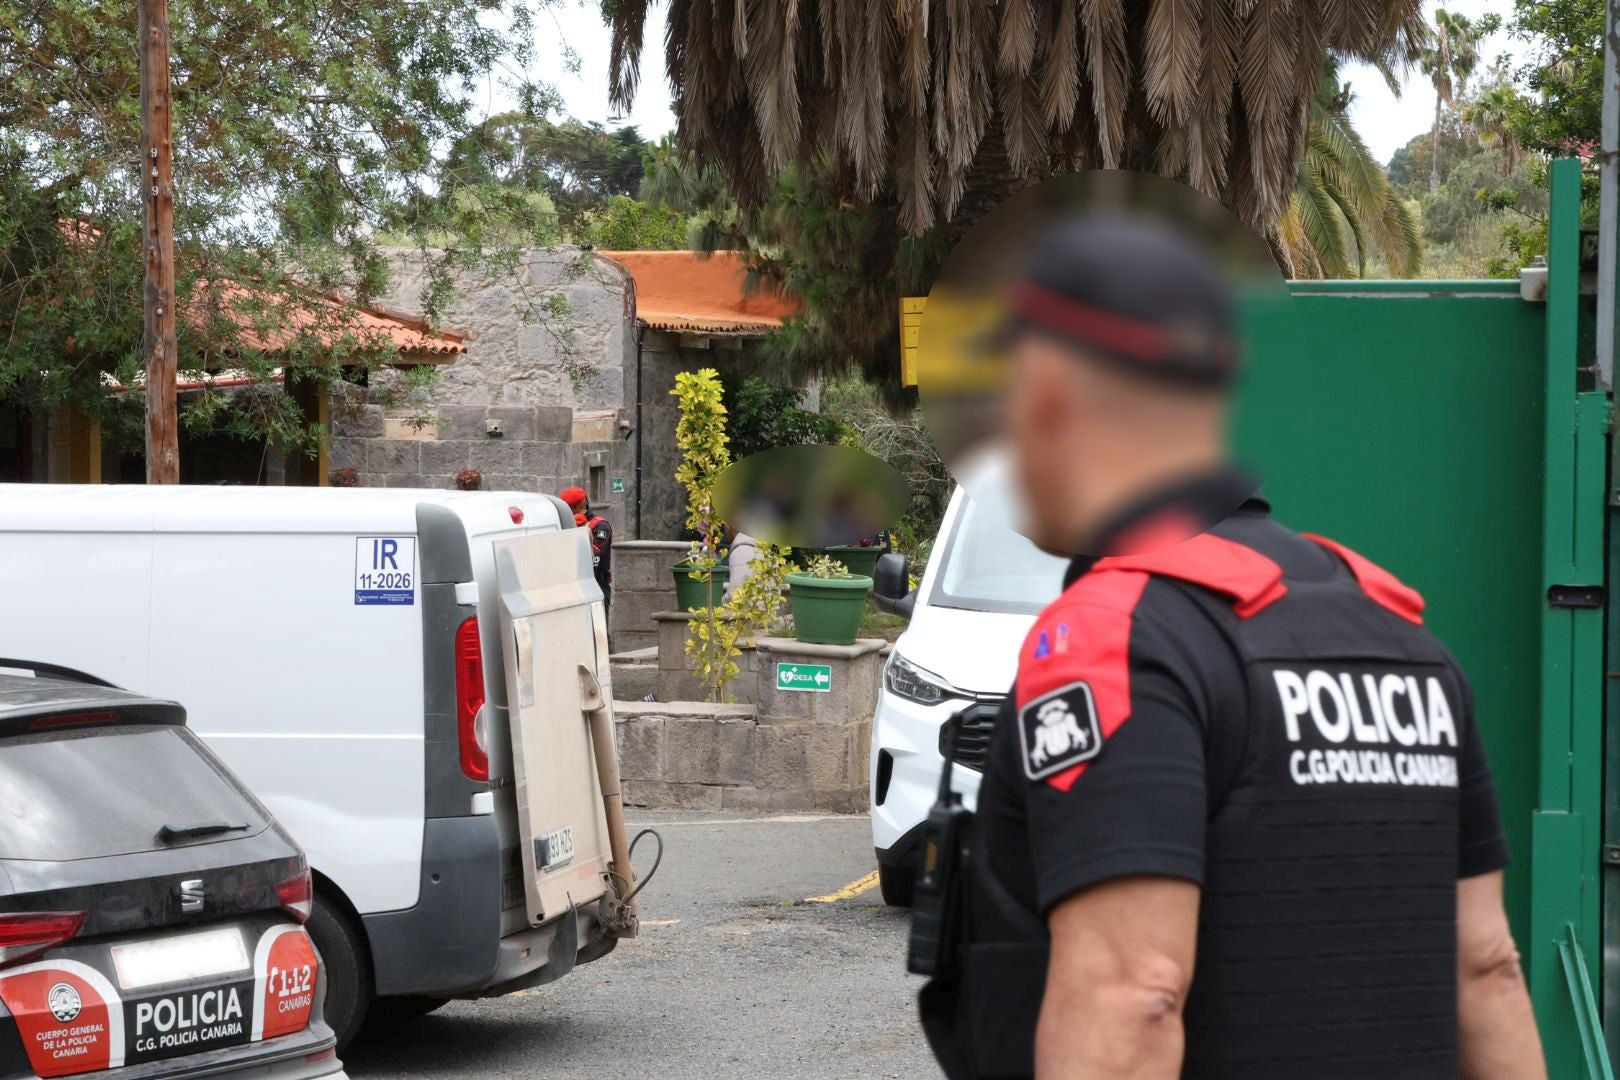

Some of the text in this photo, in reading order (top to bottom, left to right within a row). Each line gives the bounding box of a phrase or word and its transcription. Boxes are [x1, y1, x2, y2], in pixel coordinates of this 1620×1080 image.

[373, 539, 398, 570] IR
[360, 573, 411, 589] 11-2026
[1273, 669, 1458, 747] POLICIA
[136, 987, 242, 1036] POLICIA
[279, 993, 311, 1013] CANARIAS
[36, 1023, 104, 1041] CUERPO GENERAL
[136, 1022, 243, 1052] C.G. POLICIA CANARIA
[43, 1035, 97, 1050] DE LA POLICIA
[53, 1045, 88, 1058] CANARIA
